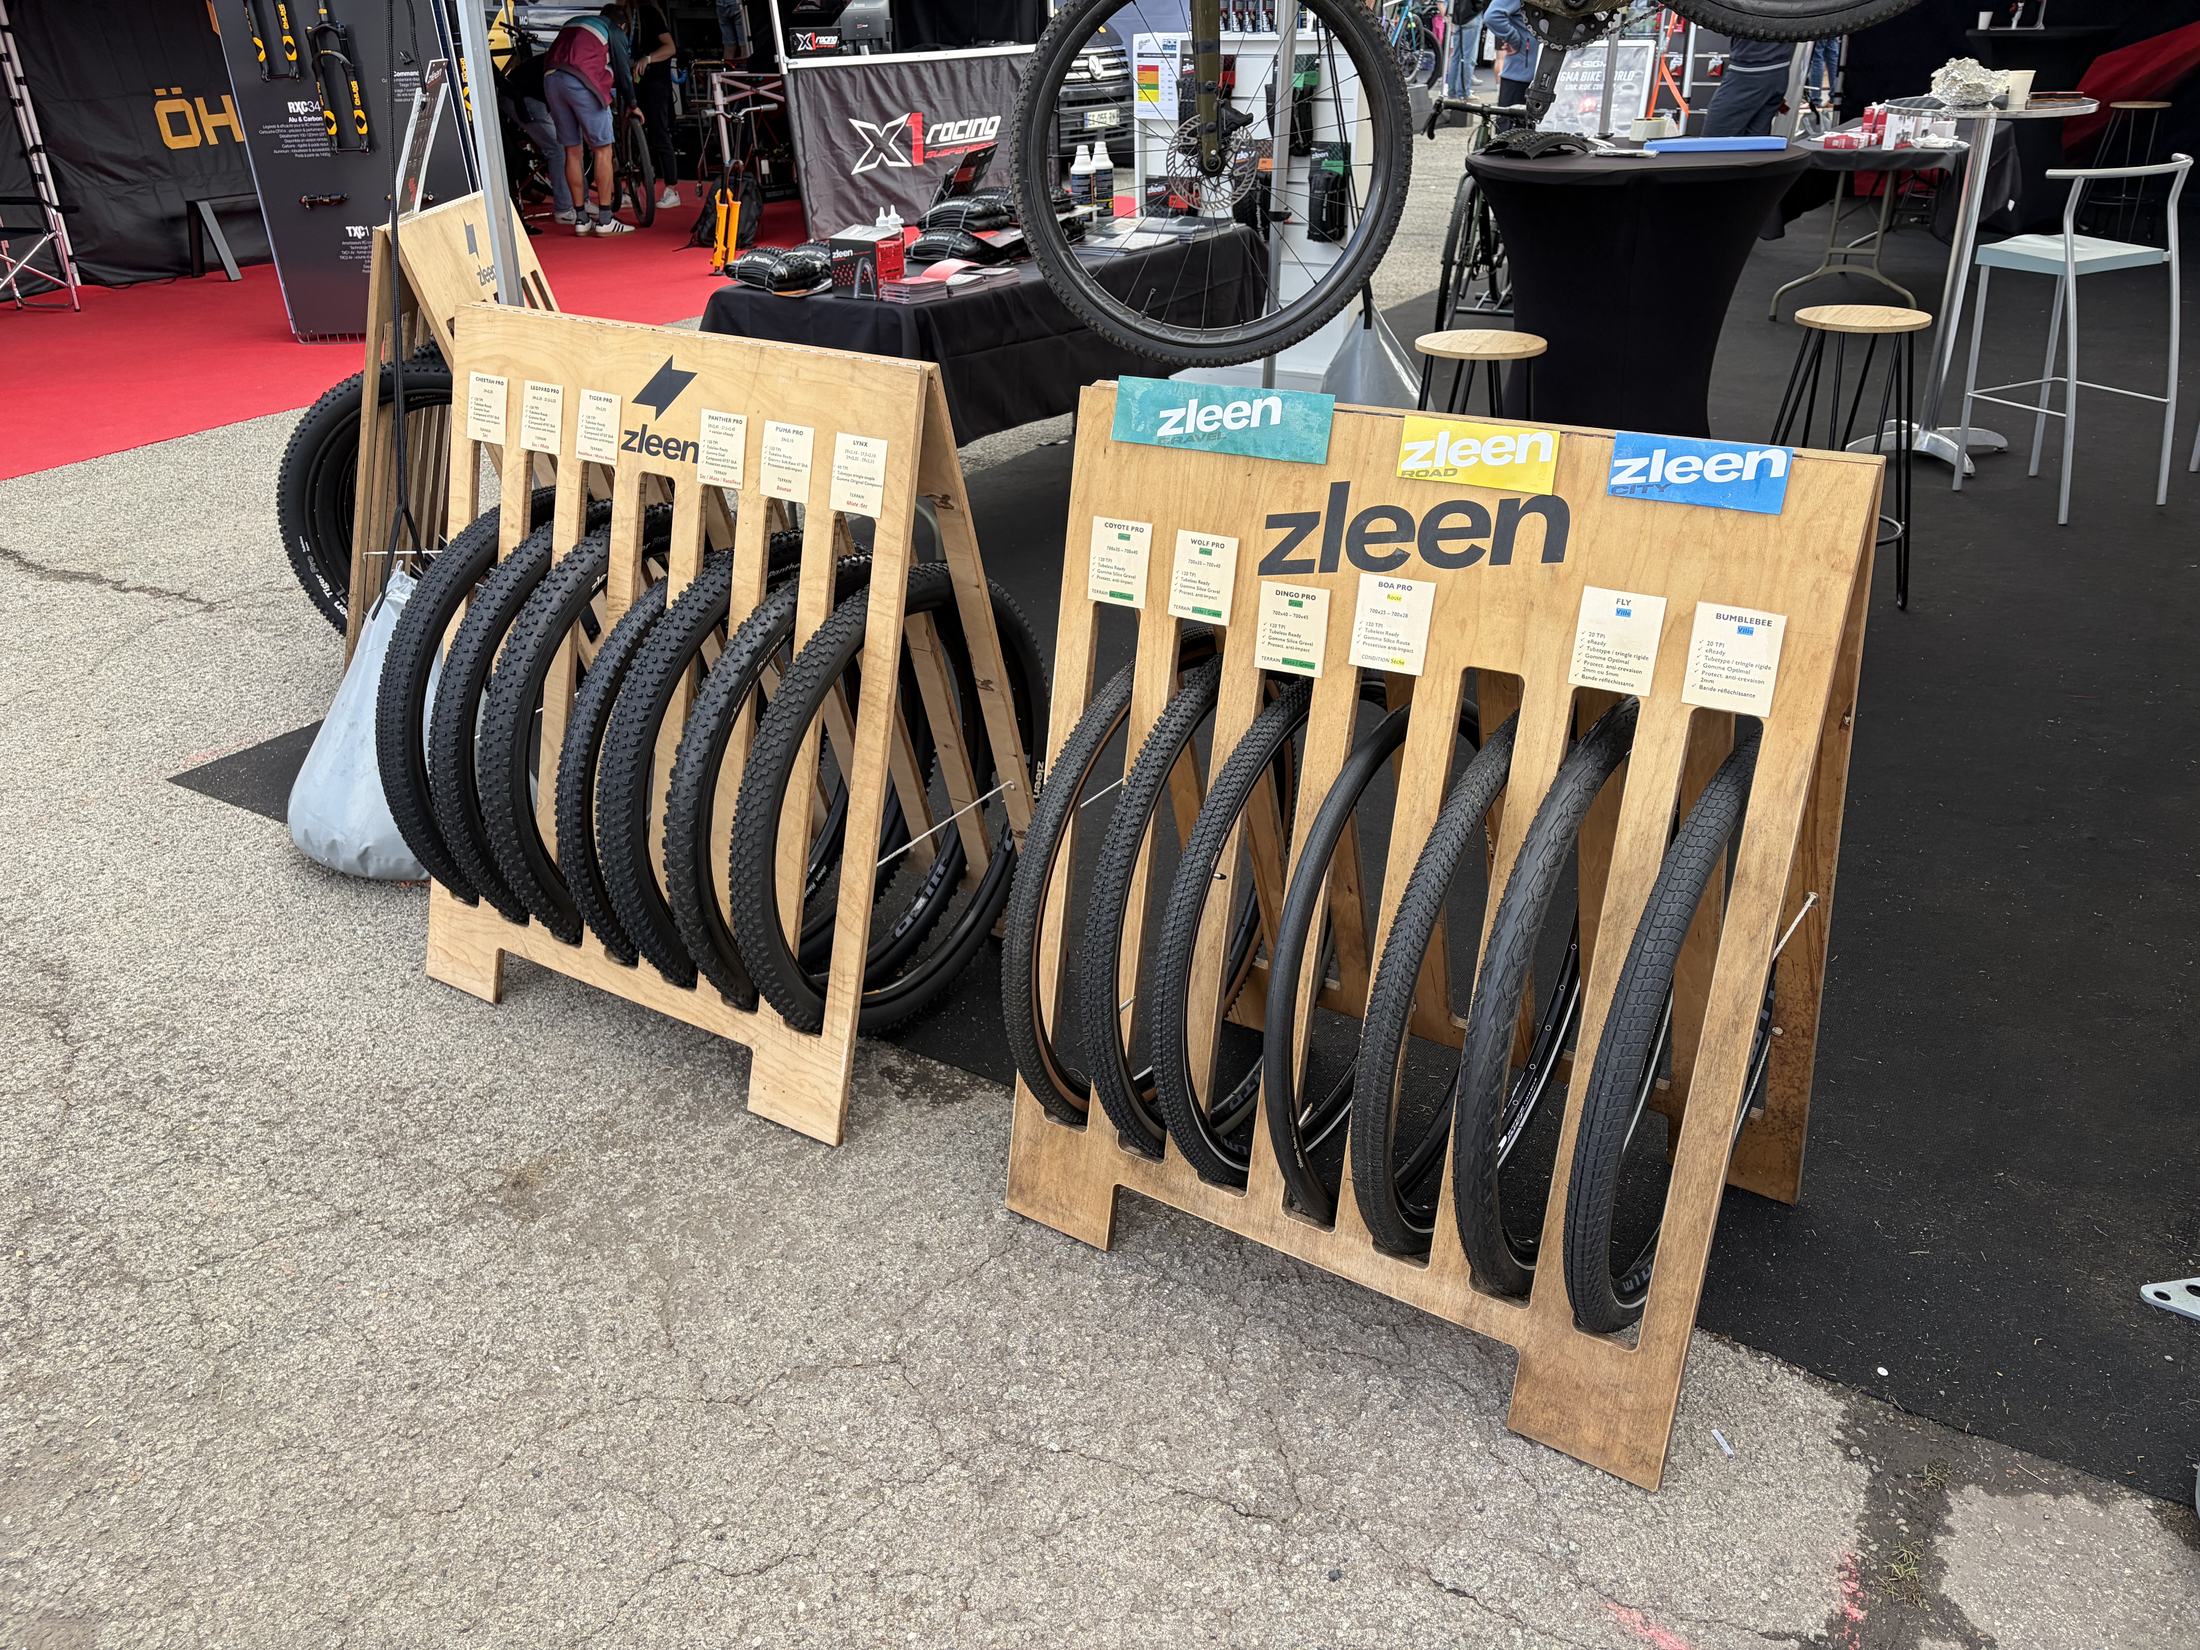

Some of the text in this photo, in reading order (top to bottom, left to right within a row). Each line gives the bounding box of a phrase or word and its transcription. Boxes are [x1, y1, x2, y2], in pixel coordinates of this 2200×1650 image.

[288, 101, 321, 114] RXC34
[154, 87, 244, 150] ÖH
[925, 115, 1002, 145] racing
[752, 255, 774, 265] Panther
[832, 249, 853, 259] zleen
[708, 415, 732, 423] PANTHER
[1157, 396, 1282, 437] zleen
[621, 424, 700, 464] zleen
[1158, 432, 1228, 445] GRAVEL
[1401, 430, 1553, 471] zleen
[1401, 467, 1458, 479] ROAD
[1610, 449, 1787, 485] zleen
[1611, 484, 1673, 495] CITY
[1104, 522, 1145, 533] COYOTE PRO
[1257, 480, 1571, 577] zleen
[1191, 538, 1225, 549] WOLF PRO
[768, 562, 800, 578] Panthe
[316, 574, 333, 598] Tiger
[1378, 581, 1413, 592] BOA PRO
[1275, 589, 1316, 601] DINGO PRO
[1616, 598, 1632, 606] FLY
[1616, 609, 1631, 617] Ville
[1716, 613, 1773, 627] BUMBLEBEE
[1288, 631, 1302, 639] Ready
[1738, 626, 1754, 635] Ville
[1587, 639, 1606, 647] eReady
[1586, 646, 1610, 655] Tubetype
[1615, 651, 1632, 659] tringle
[1705, 648, 1726, 656] eReady
[1261, 655, 1281, 663] TERRAIN
[1361, 654, 1390, 663] CONDITION
[1585, 653, 1630, 665] Gomme Optimal
[1704, 655, 1730, 664] Tubetype
[1735, 660, 1754, 669] tringle
[1606, 664, 1643, 674] anti-crevaison
[1703, 663, 1751, 675] Gomme Optimal
[1033, 761, 1044, 799] zleen
